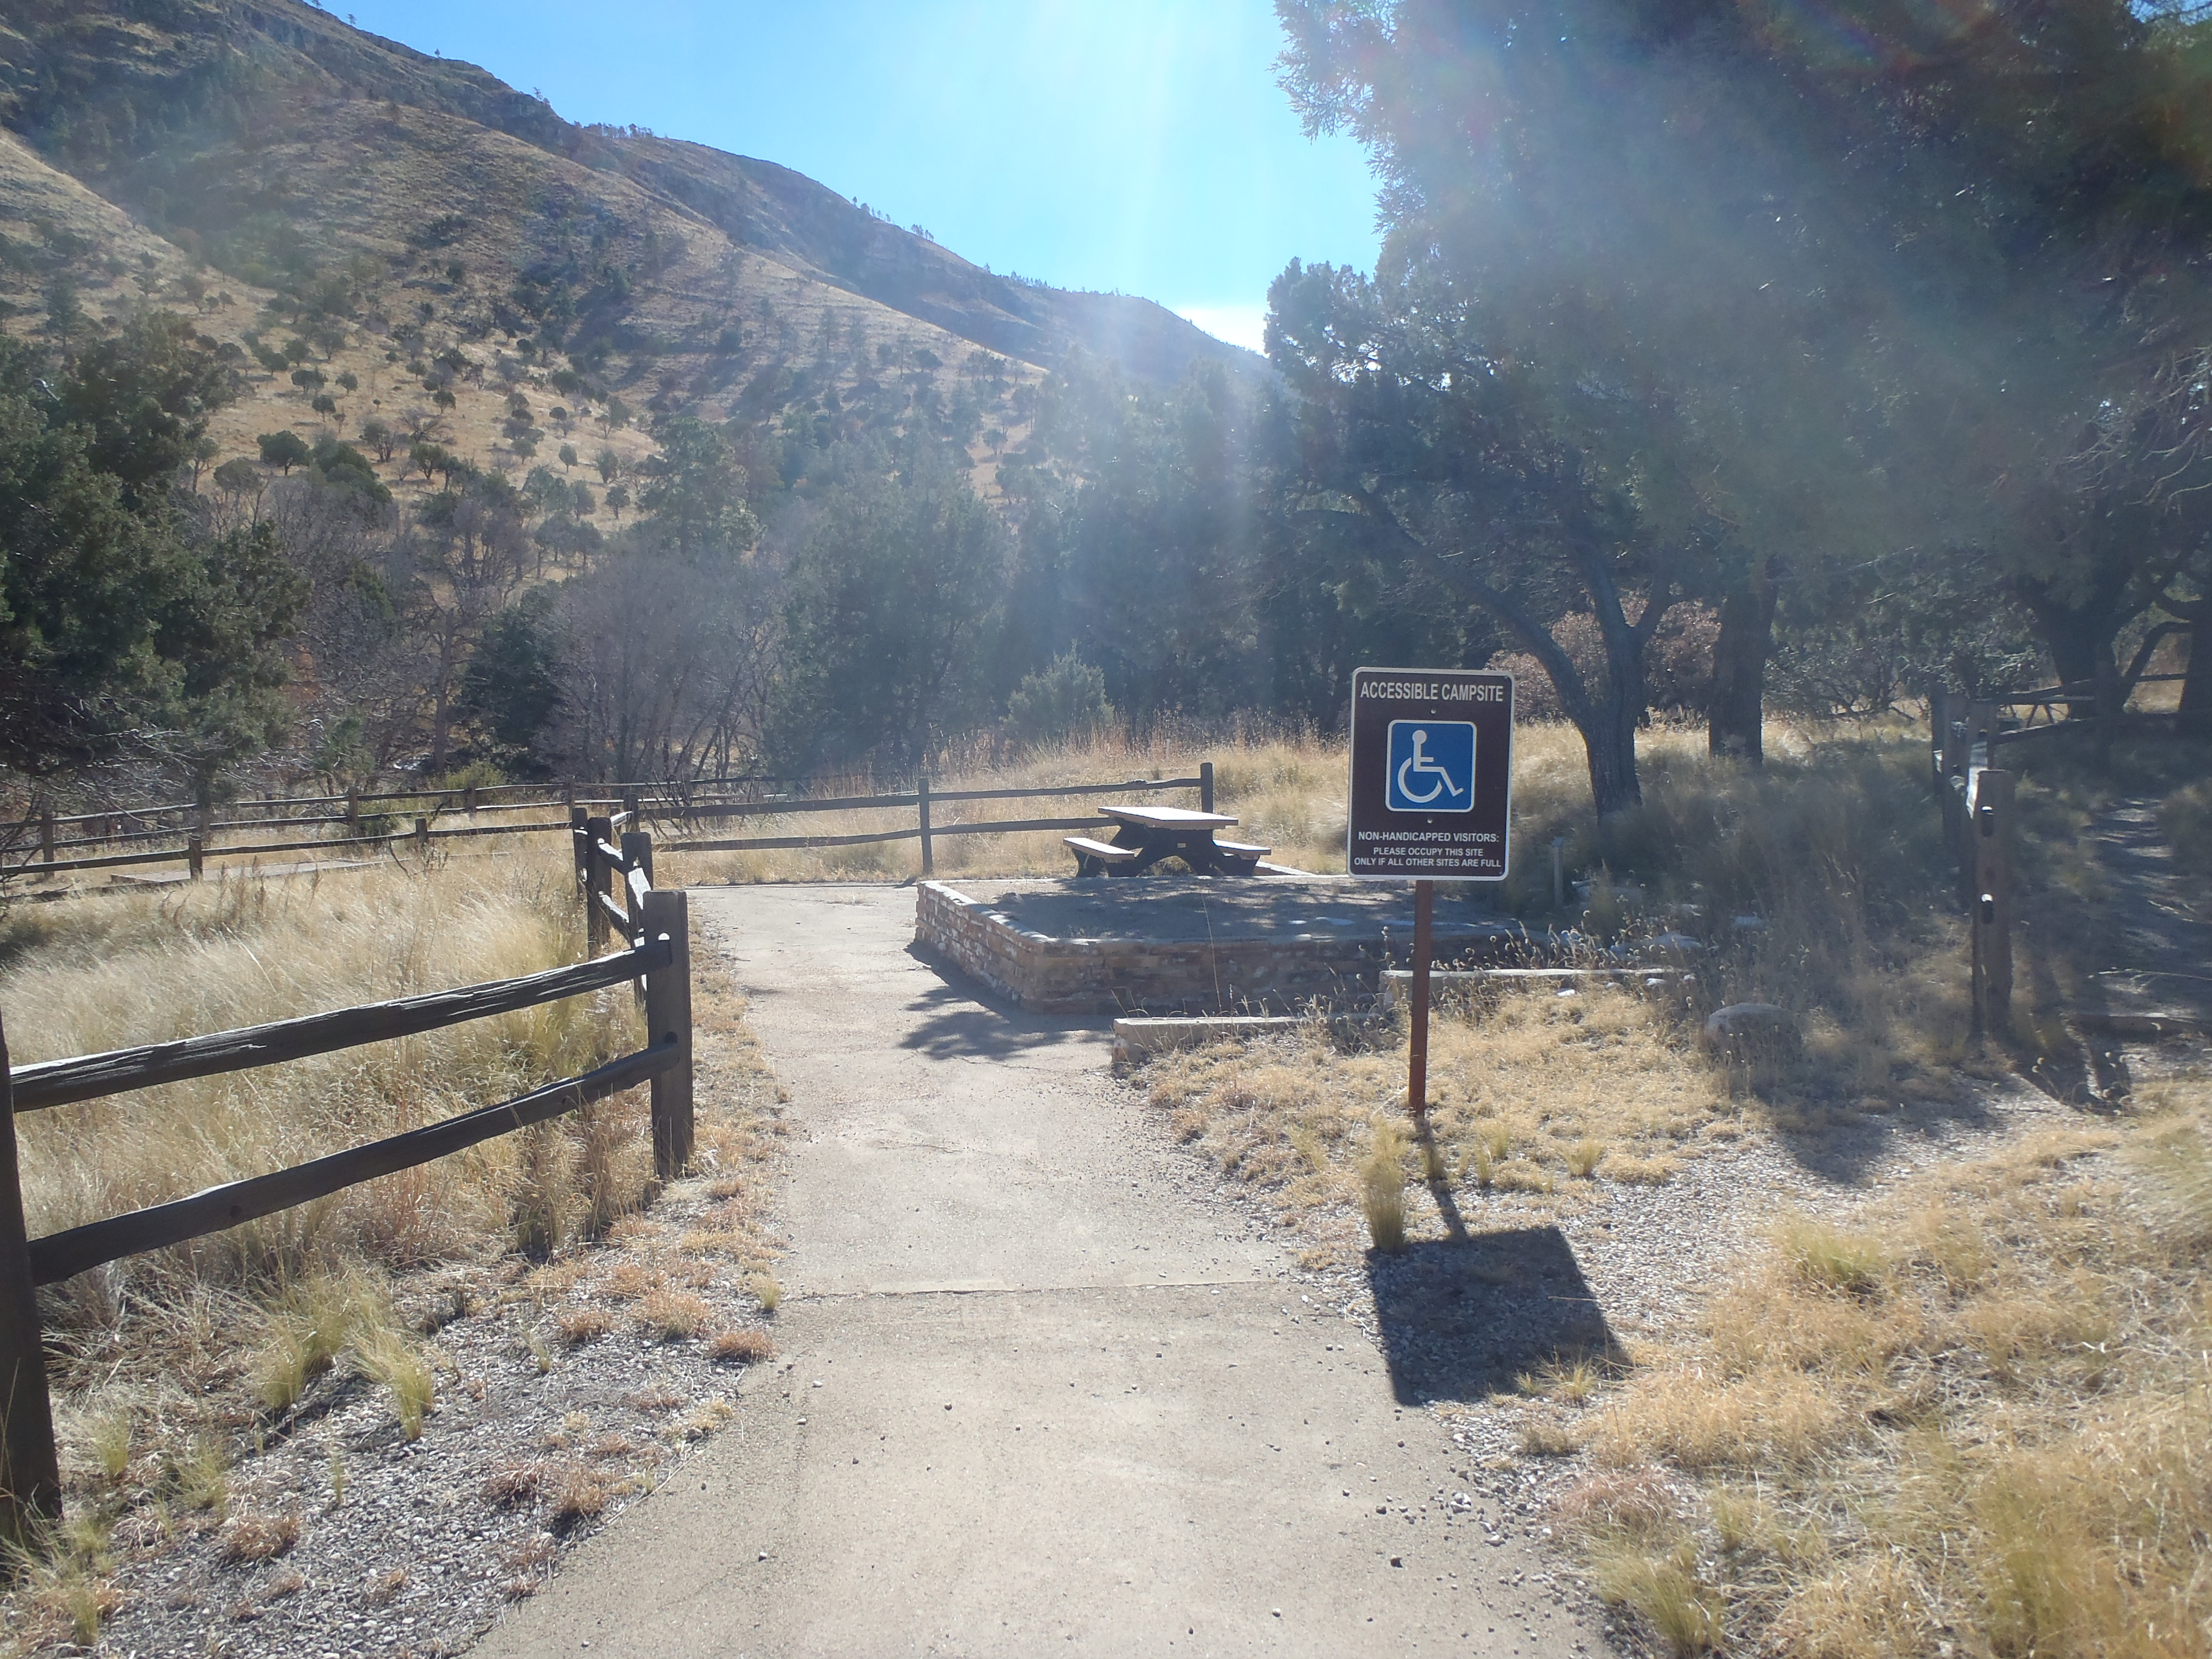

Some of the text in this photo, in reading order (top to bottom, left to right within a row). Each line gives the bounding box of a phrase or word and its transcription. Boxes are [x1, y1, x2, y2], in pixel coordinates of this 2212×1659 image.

[1361, 682, 1503, 701] ACCESSIBLE CAMPSITE
[1359, 832, 1499, 842] NON-HANDICAPPED VISITORS:
